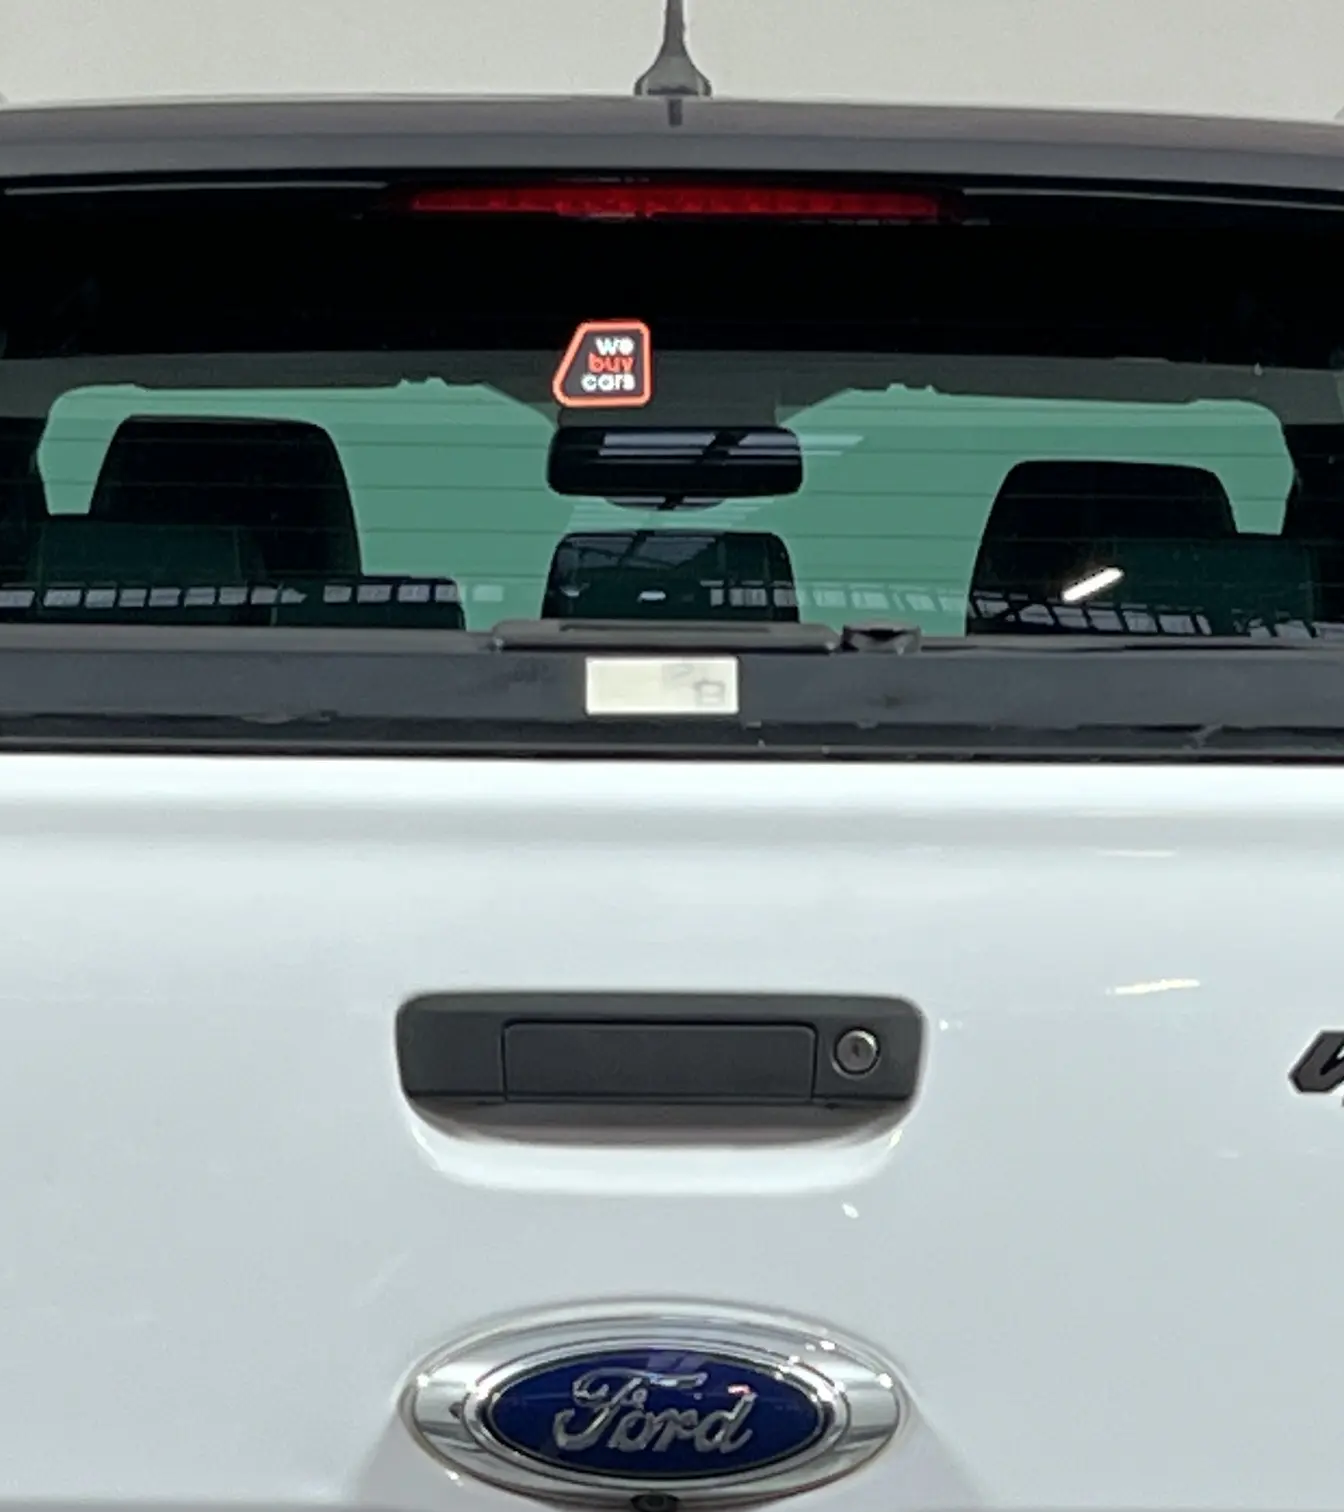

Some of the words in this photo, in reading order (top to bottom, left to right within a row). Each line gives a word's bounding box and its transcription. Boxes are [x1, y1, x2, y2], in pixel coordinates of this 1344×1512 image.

[595, 337, 635, 355] we
[588, 353, 634, 373] buy
[580, 374, 636, 391] cars
[554, 1368, 758, 1453] Ford
